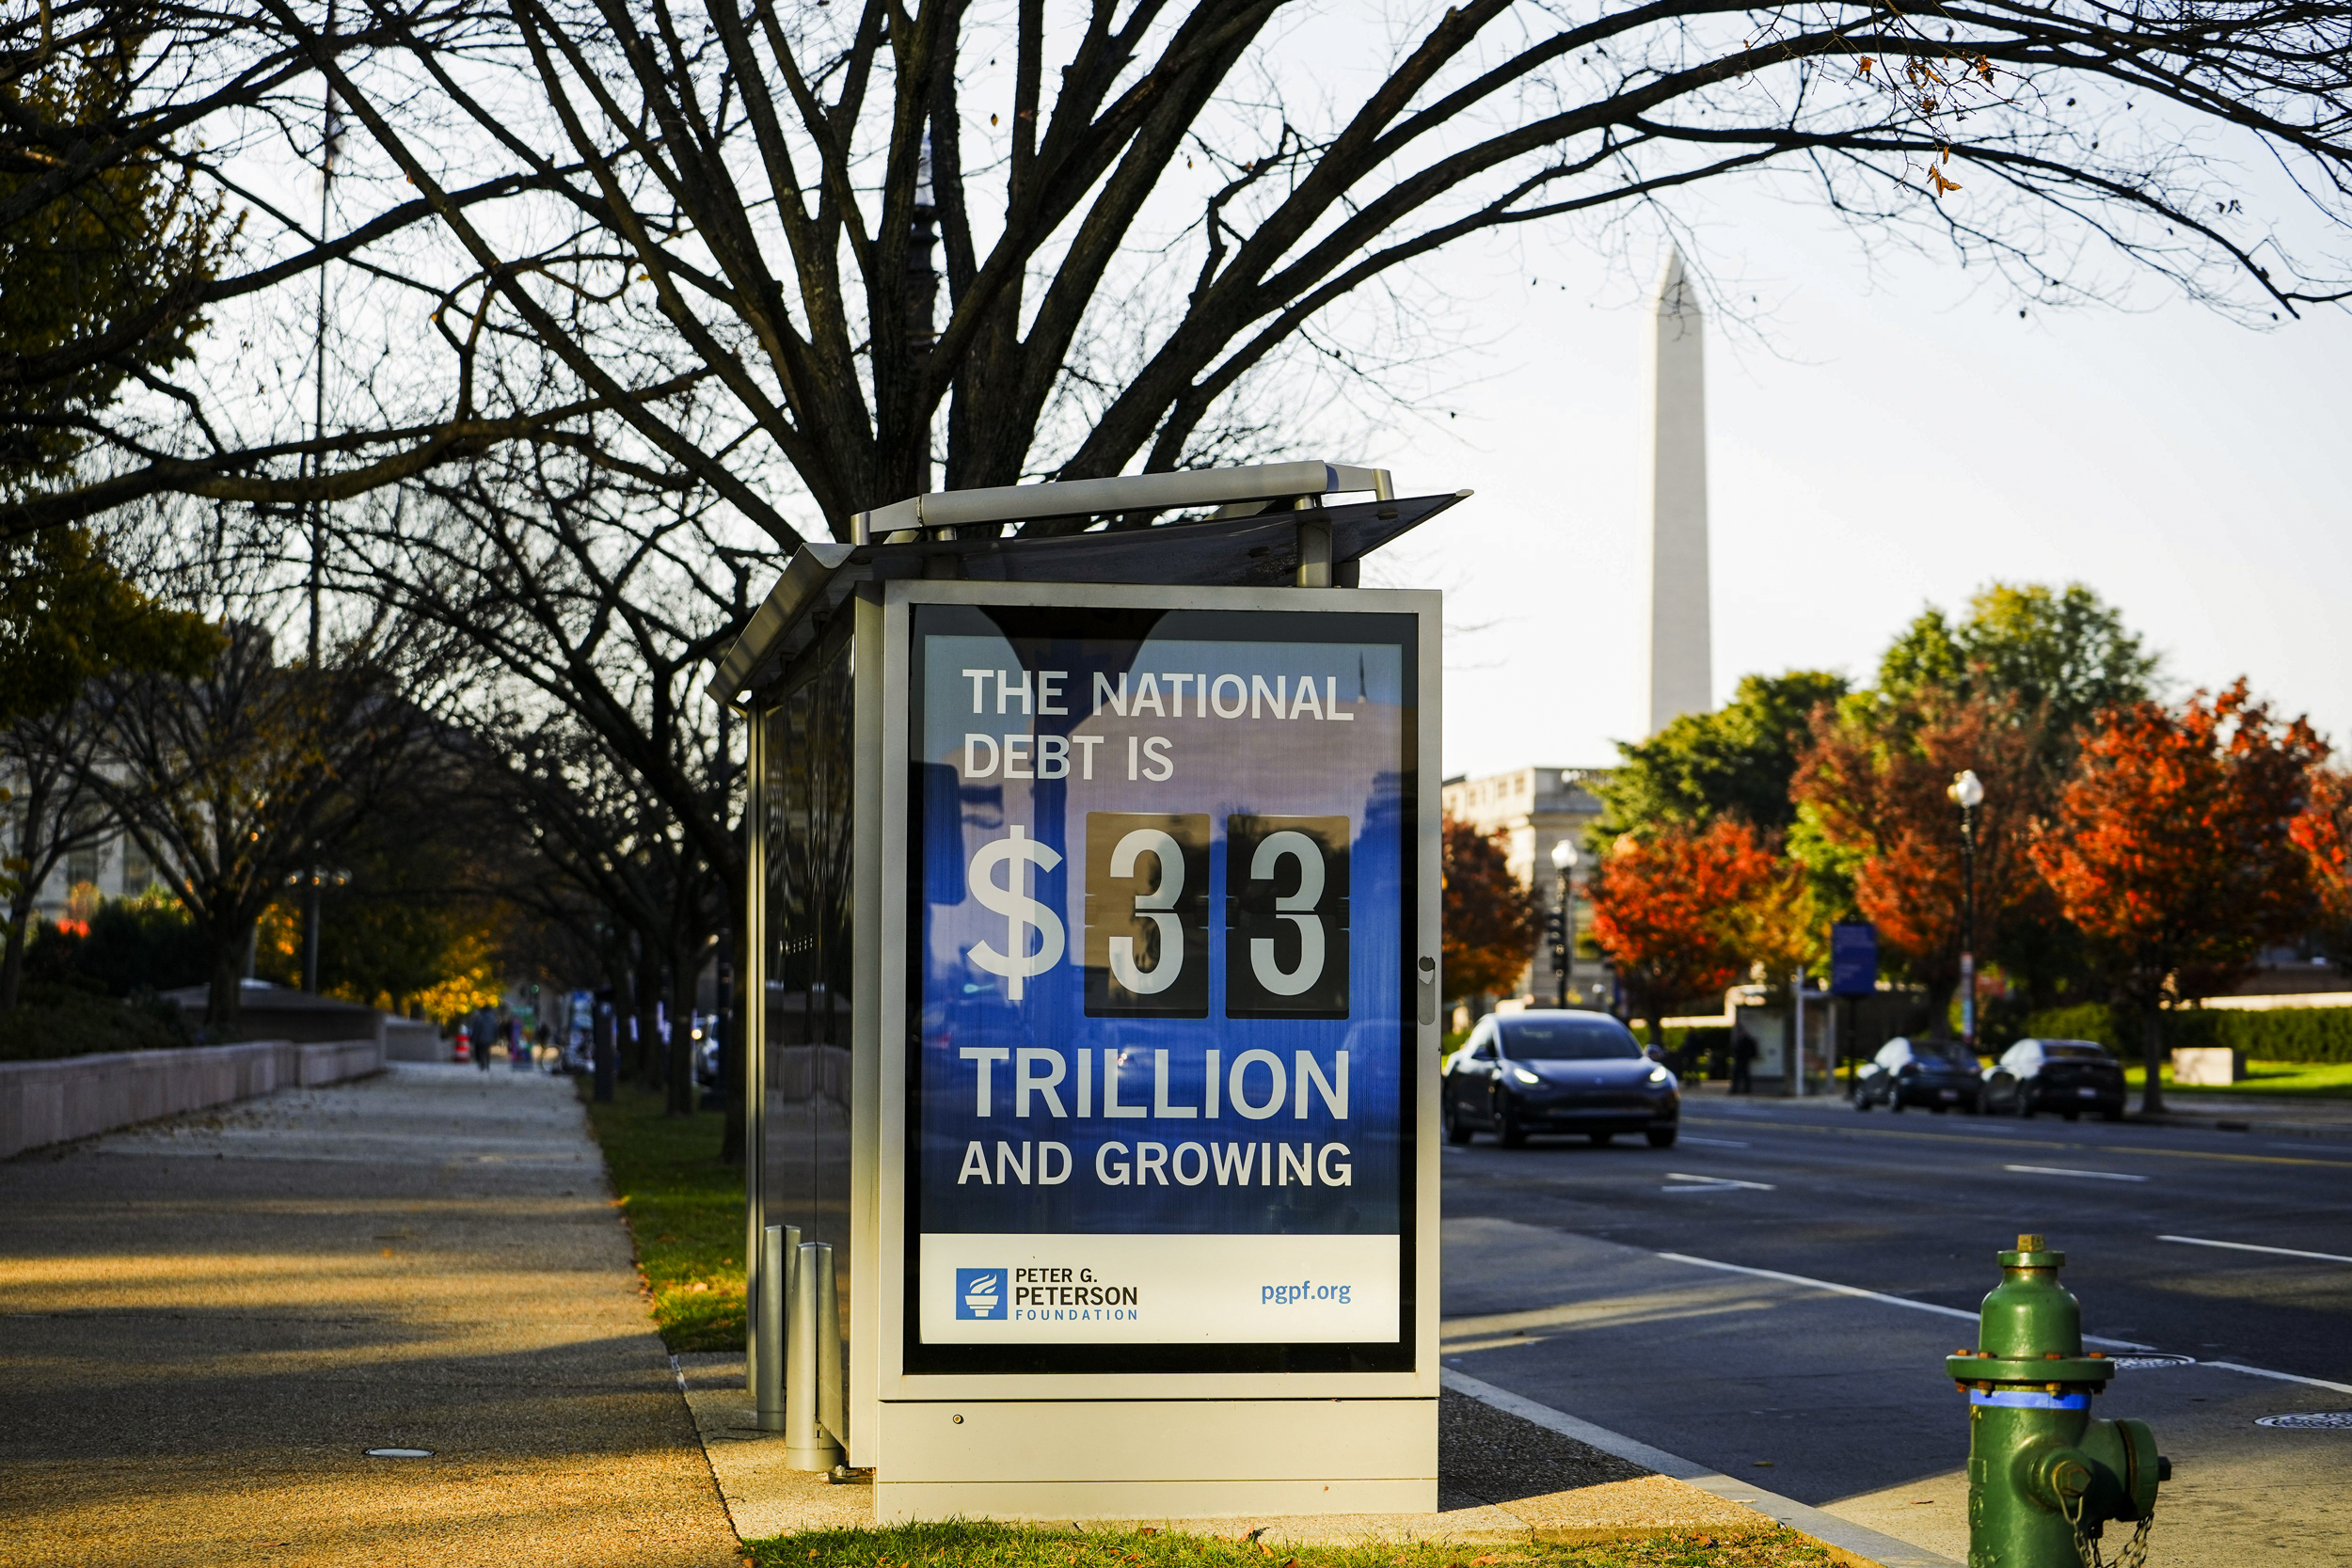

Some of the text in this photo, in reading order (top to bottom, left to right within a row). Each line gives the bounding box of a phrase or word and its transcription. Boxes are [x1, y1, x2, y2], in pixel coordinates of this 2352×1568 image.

[962, 669, 1355, 721] THE NATIONAL
[964, 733, 1174, 782] DEBT IS
[959, 1046, 1349, 1120] TRILLION
[957, 1140, 1353, 1187] AND GROWING
[1015, 1267, 1098, 1283] PETER G.
[1262, 1280, 1351, 1305] pgpf.org
[1015, 1286, 1137, 1306] PETERSON
[1015, 1309, 1137, 1321] FOUNDATION
